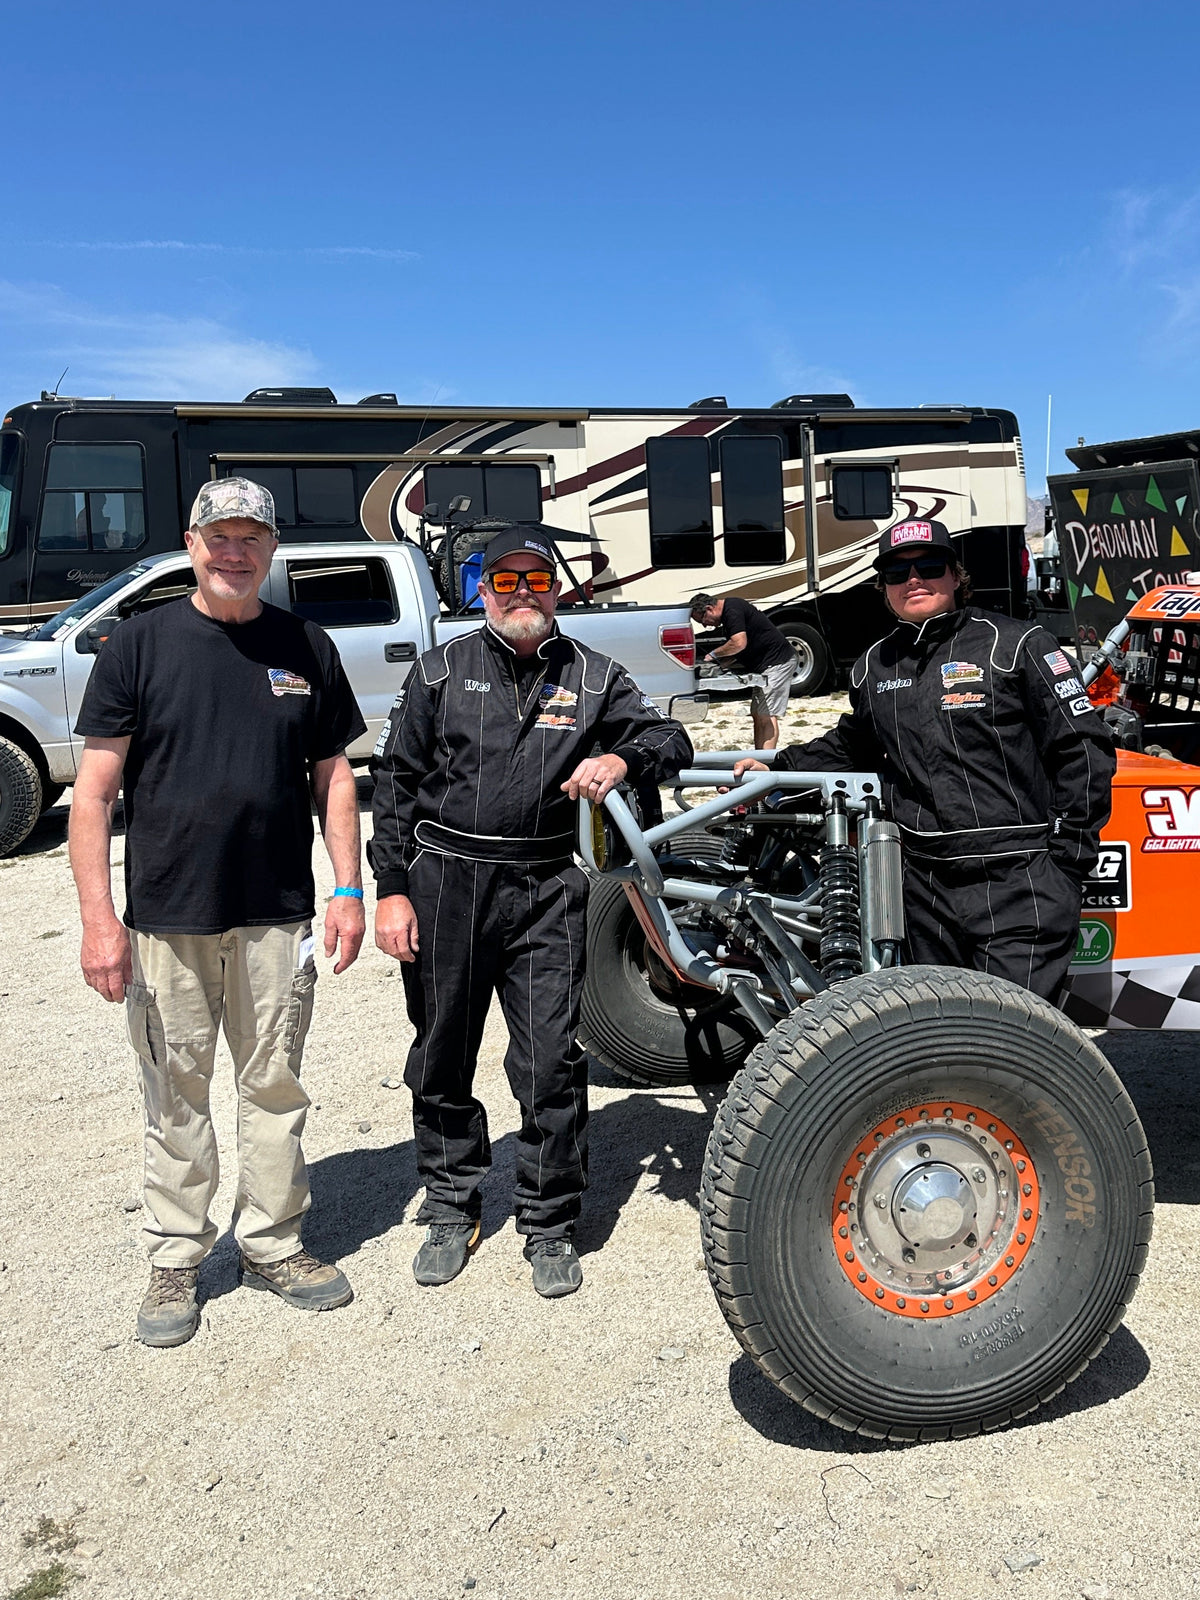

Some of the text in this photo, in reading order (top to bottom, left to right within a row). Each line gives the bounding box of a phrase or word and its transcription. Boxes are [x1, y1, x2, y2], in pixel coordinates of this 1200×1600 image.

[1065, 518, 1159, 575] DEADMAN
[464, 679, 491, 692] Wes
[1082, 896, 1121, 905] CKS
[1024, 1100, 1097, 1227] TENSOR
